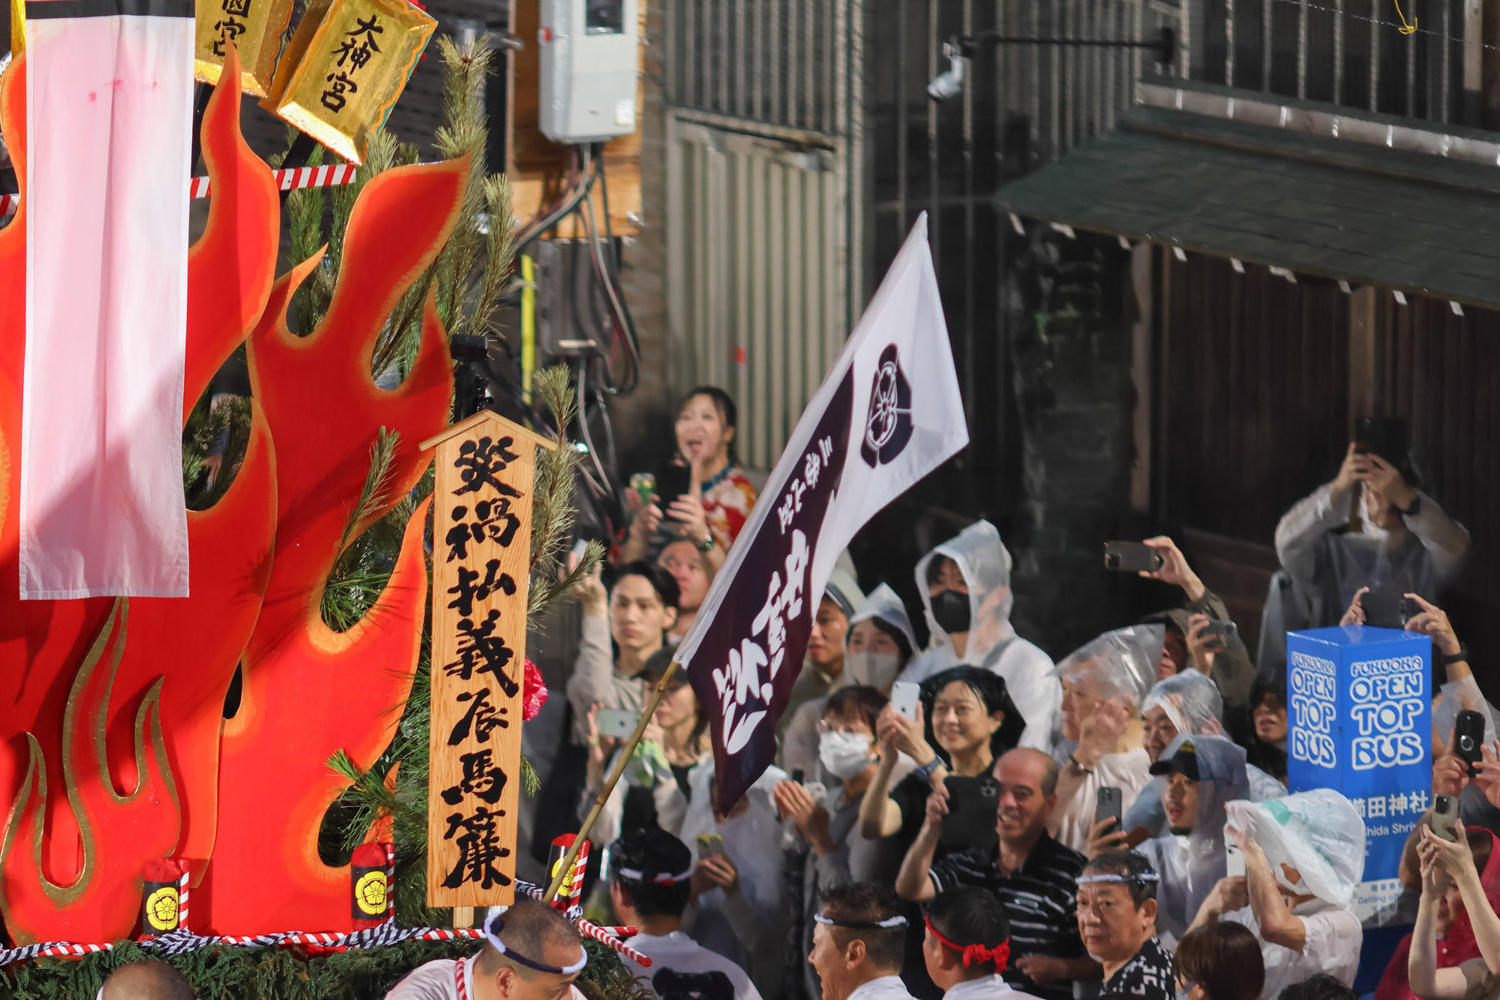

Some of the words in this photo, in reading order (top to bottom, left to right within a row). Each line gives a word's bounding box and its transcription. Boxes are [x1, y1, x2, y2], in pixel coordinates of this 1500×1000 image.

[320, 15, 384, 114] 大神宮
[1291, 651, 1336, 676] FUKUOKA
[1350, 656, 1423, 677] FUKUOKA
[1291, 667, 1336, 702] OPEN
[1349, 671, 1423, 703] OPEN
[1292, 694, 1336, 733] TOP
[1350, 699, 1424, 735] TOP
[1293, 726, 1336, 768] BUS
[1352, 732, 1424, 770] BUS
